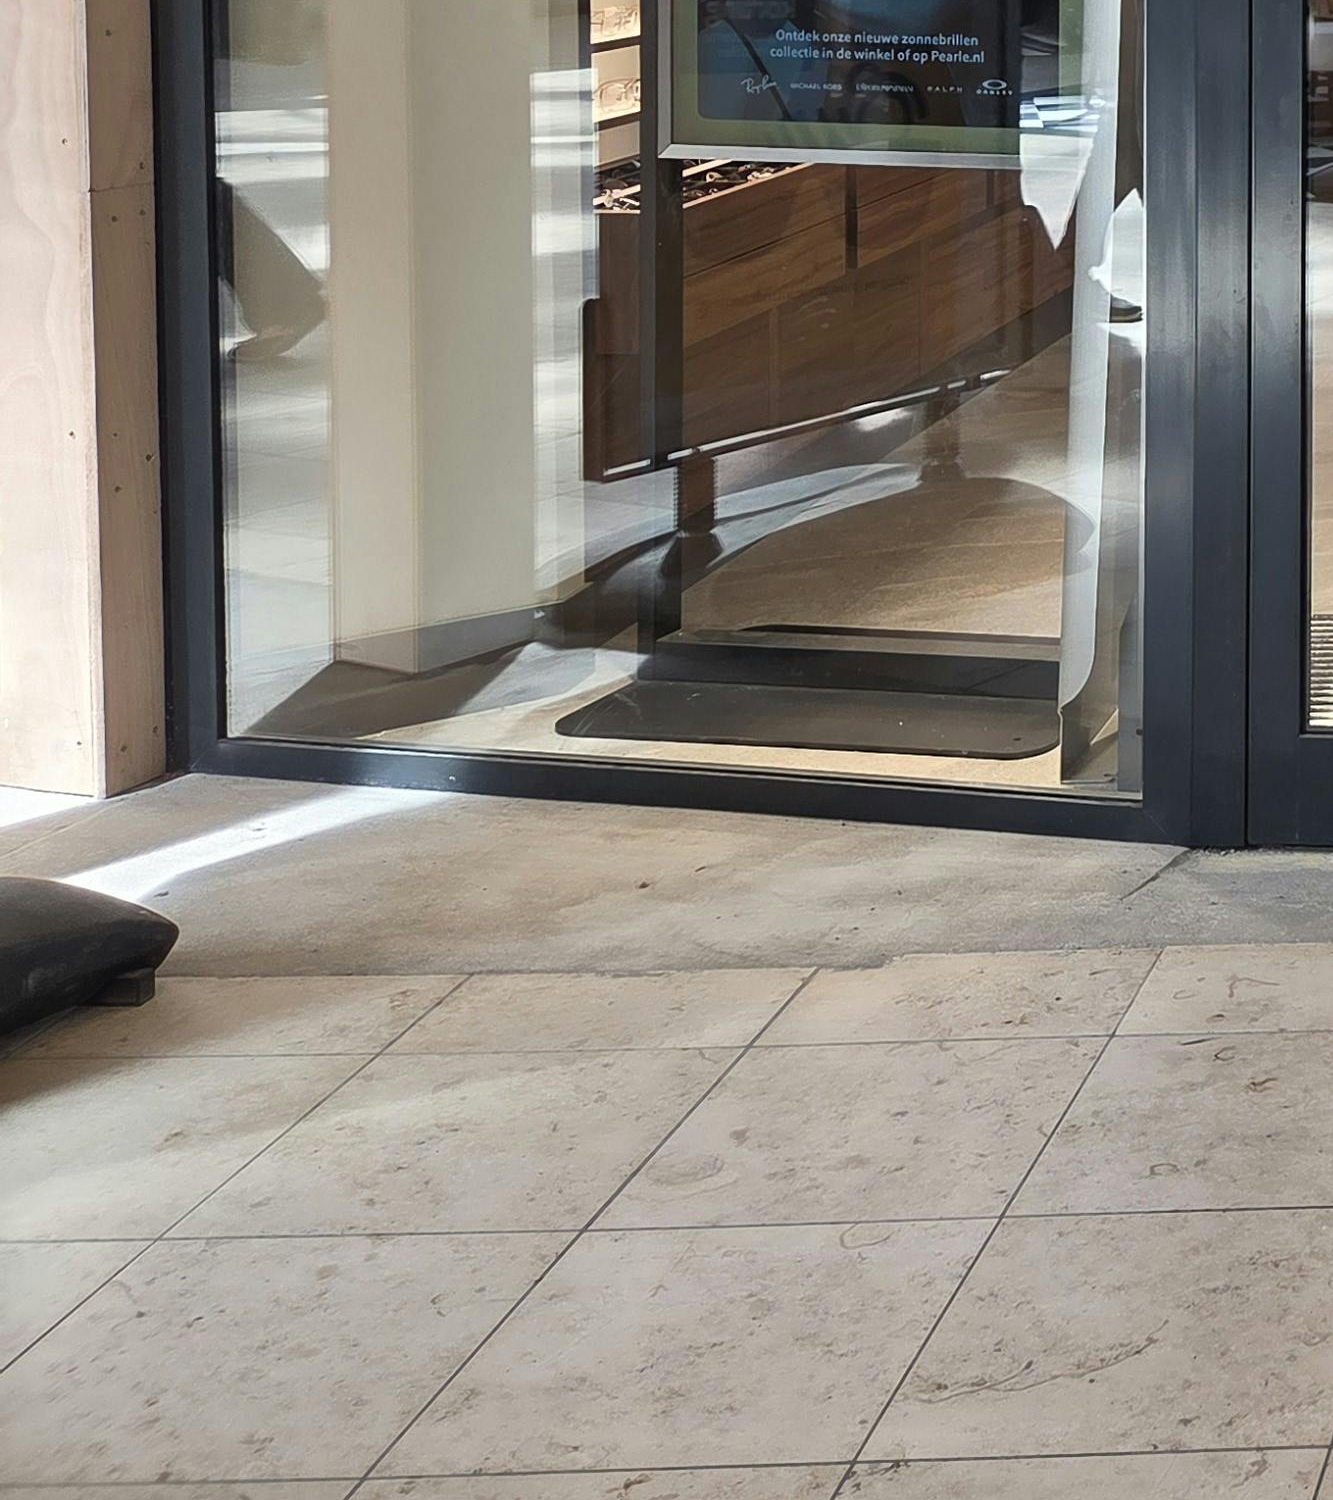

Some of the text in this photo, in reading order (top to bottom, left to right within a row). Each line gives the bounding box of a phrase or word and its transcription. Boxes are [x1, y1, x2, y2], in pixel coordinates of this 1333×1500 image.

[775, 28, 979, 46] Ontdek onze nieuwe zonnebrillen
[769, 47, 985, 65] collectie in de winkel of op Pearle.nl
